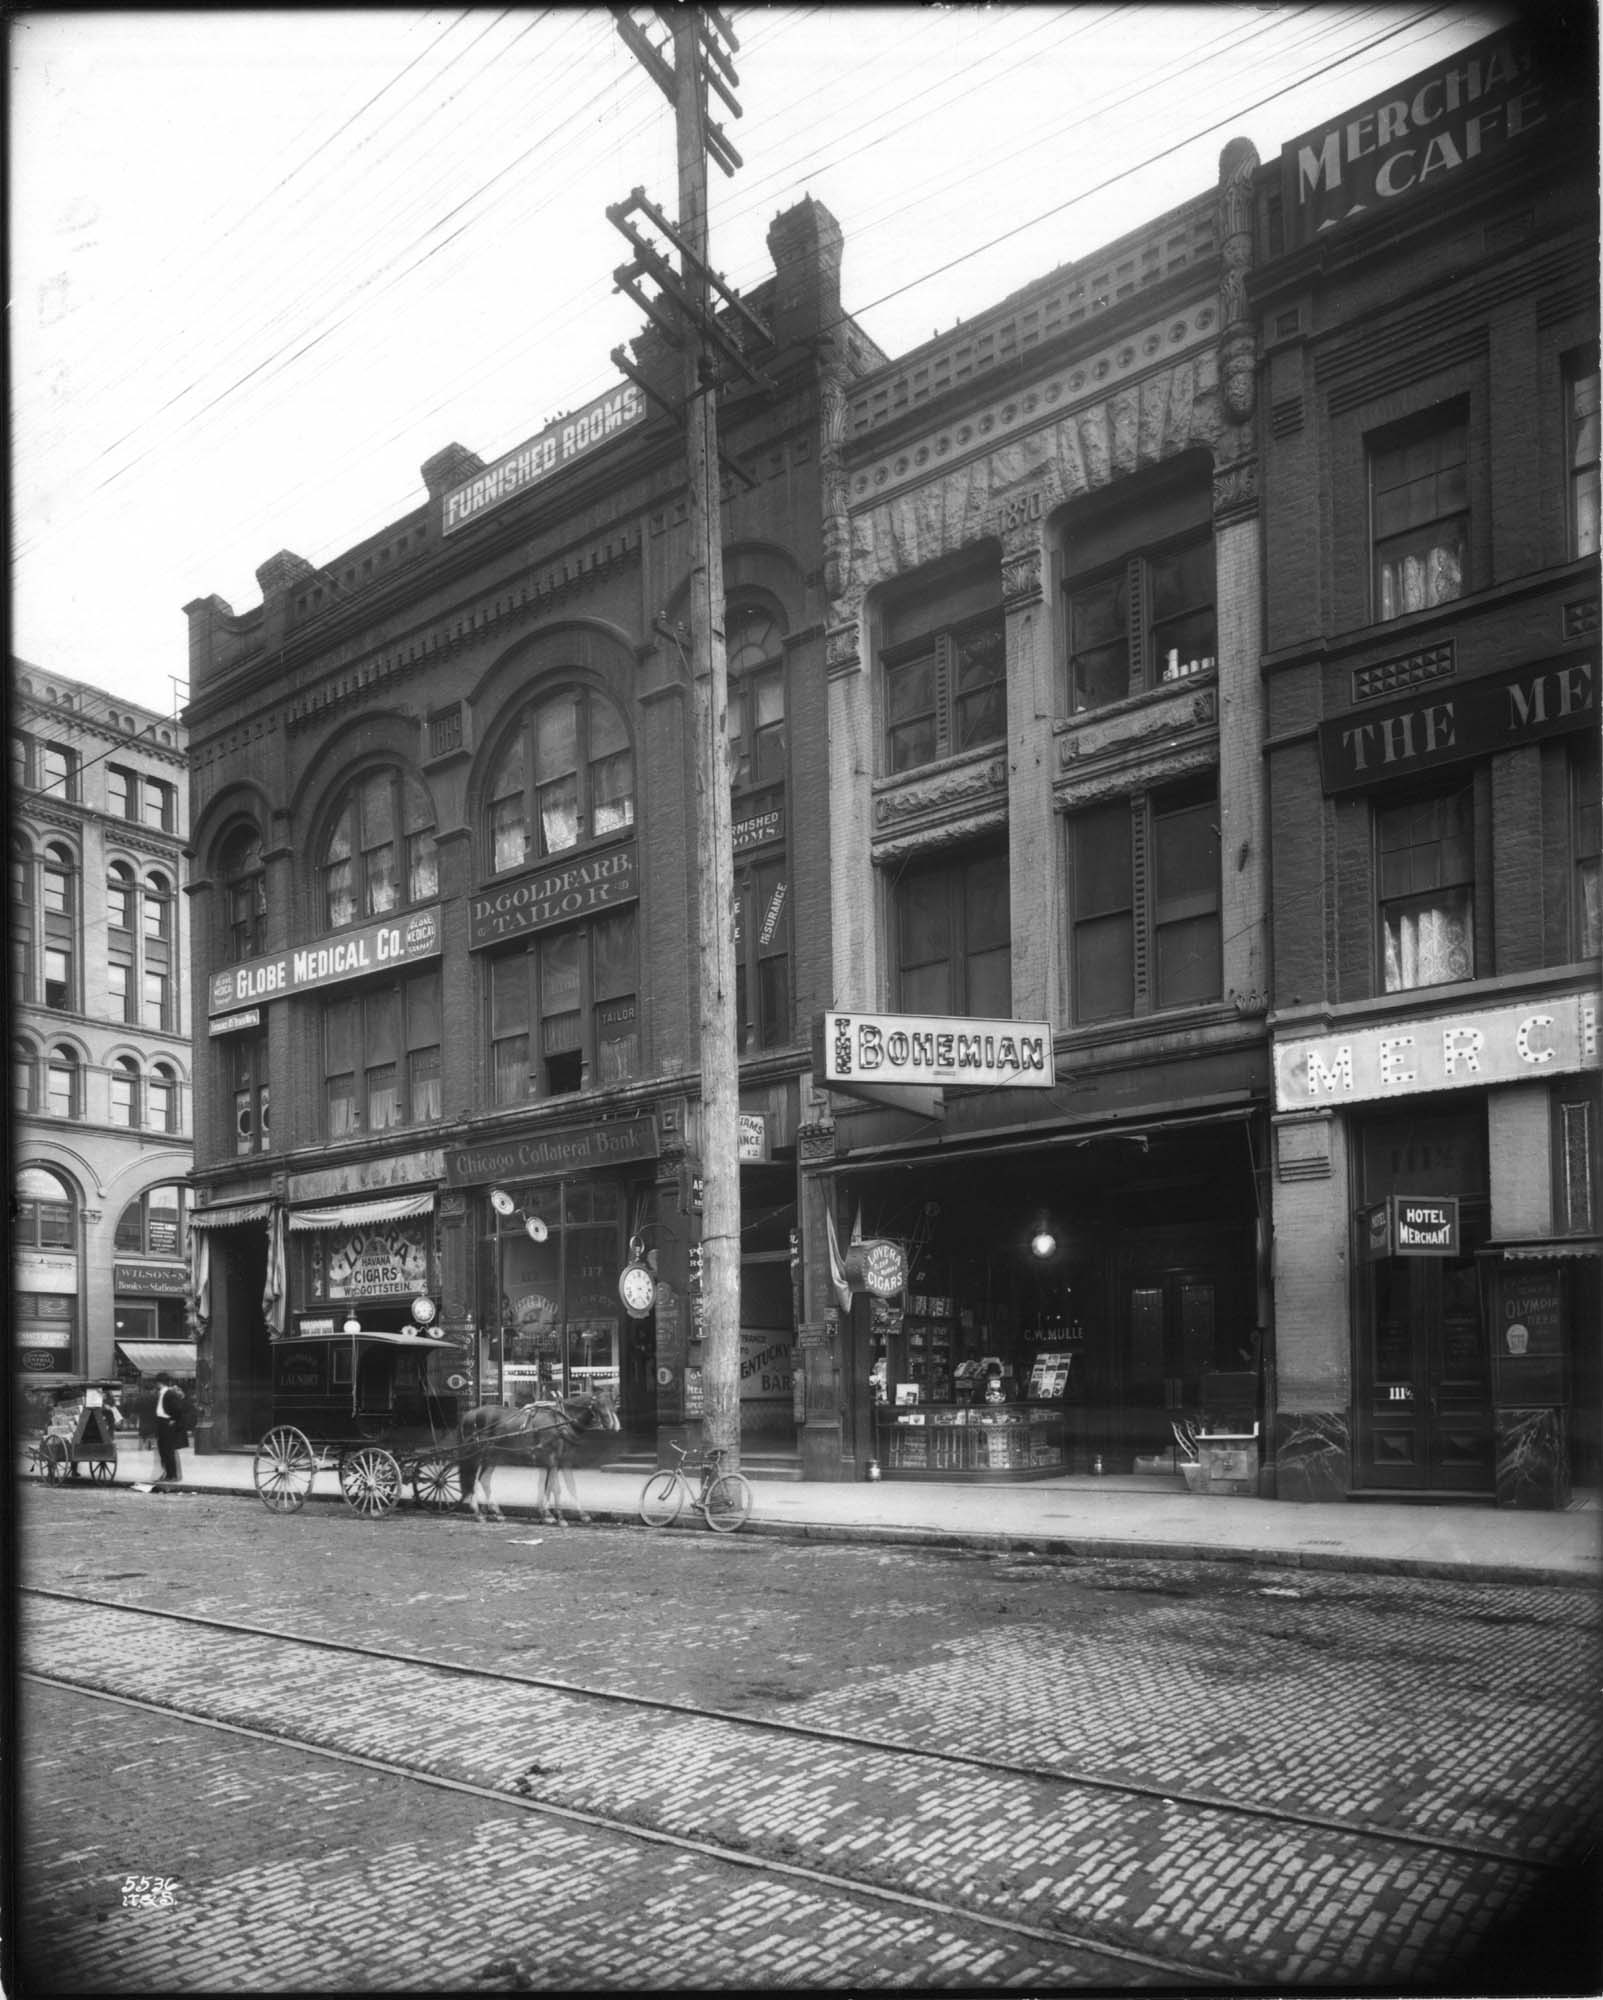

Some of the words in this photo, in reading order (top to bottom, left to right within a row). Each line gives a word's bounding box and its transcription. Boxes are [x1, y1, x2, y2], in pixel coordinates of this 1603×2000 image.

[1375, 84, 1548, 198] CAFE
[449, 438, 557, 525] FURNISHED
[563, 386, 643, 459] ROOMS.
[1342, 702, 1456, 770] THE
[493, 884, 610, 934] TAILOR
[760, 882, 788, 944] INSURANCE
[236, 961, 286, 999] GLOBE
[294, 939, 370, 984] MEDICAL
[602, 1007, 634, 1025] TAILOR
[835, 1018, 852, 1074] THE
[859, 1024, 1044, 1070] BOHEMIAN
[456, 1152, 514, 1176] Chicago
[518, 1136, 591, 1165] Collateral
[595, 1127, 640, 1153] Bank
[1399, 1221, 1450, 1245] MERCHANT
[1407, 1208, 1446, 1224] HOTEL
[354, 1267, 397, 1285] CIGARS
[361, 1255, 391, 1268] HAVANA
[867, 1245, 901, 1267] LOVERA
[867, 1271, 903, 1291] CIGARS
[740, 1344, 790, 1378] ENTUCKY
